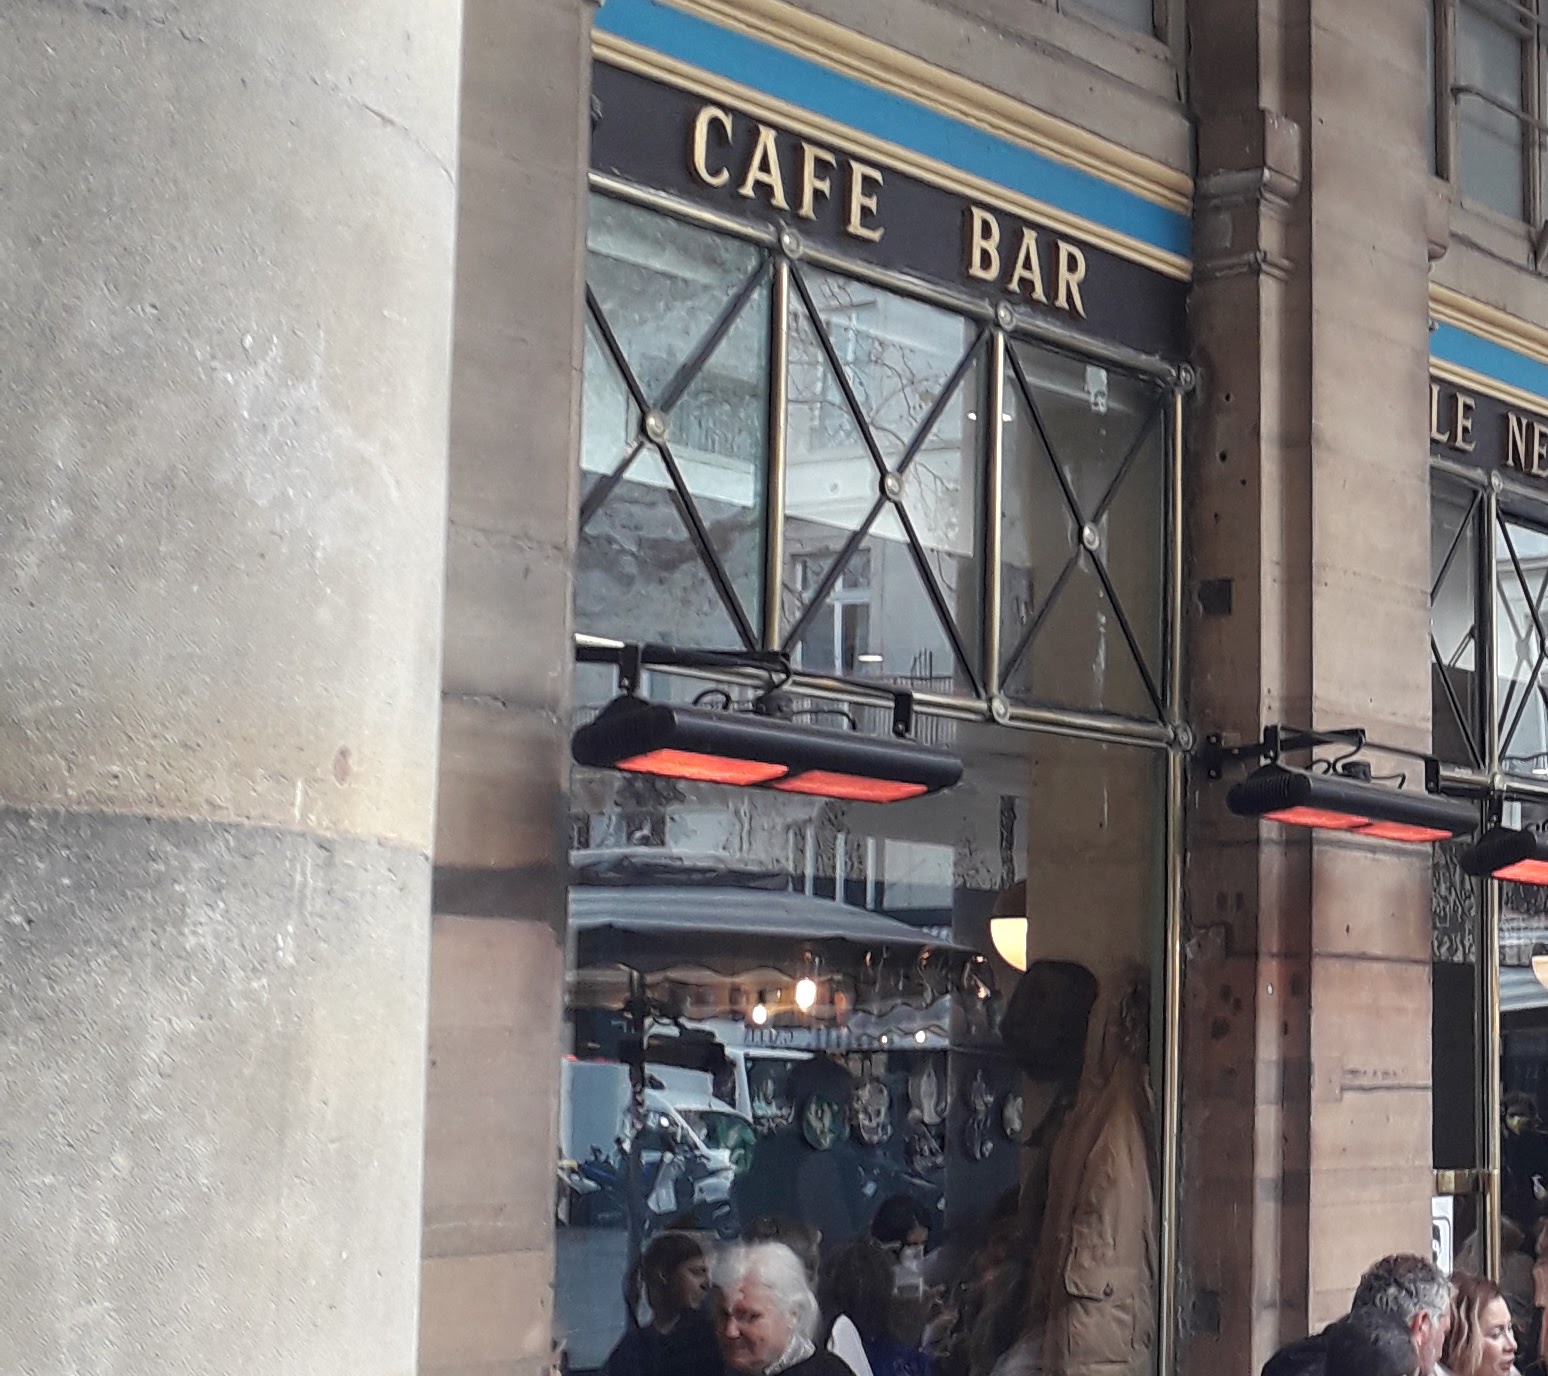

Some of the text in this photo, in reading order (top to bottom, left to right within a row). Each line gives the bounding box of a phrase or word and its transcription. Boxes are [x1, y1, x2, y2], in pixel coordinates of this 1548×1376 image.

[692, 105, 1087, 318] CAFE BAR
[1430, 383, 1477, 452] LE
